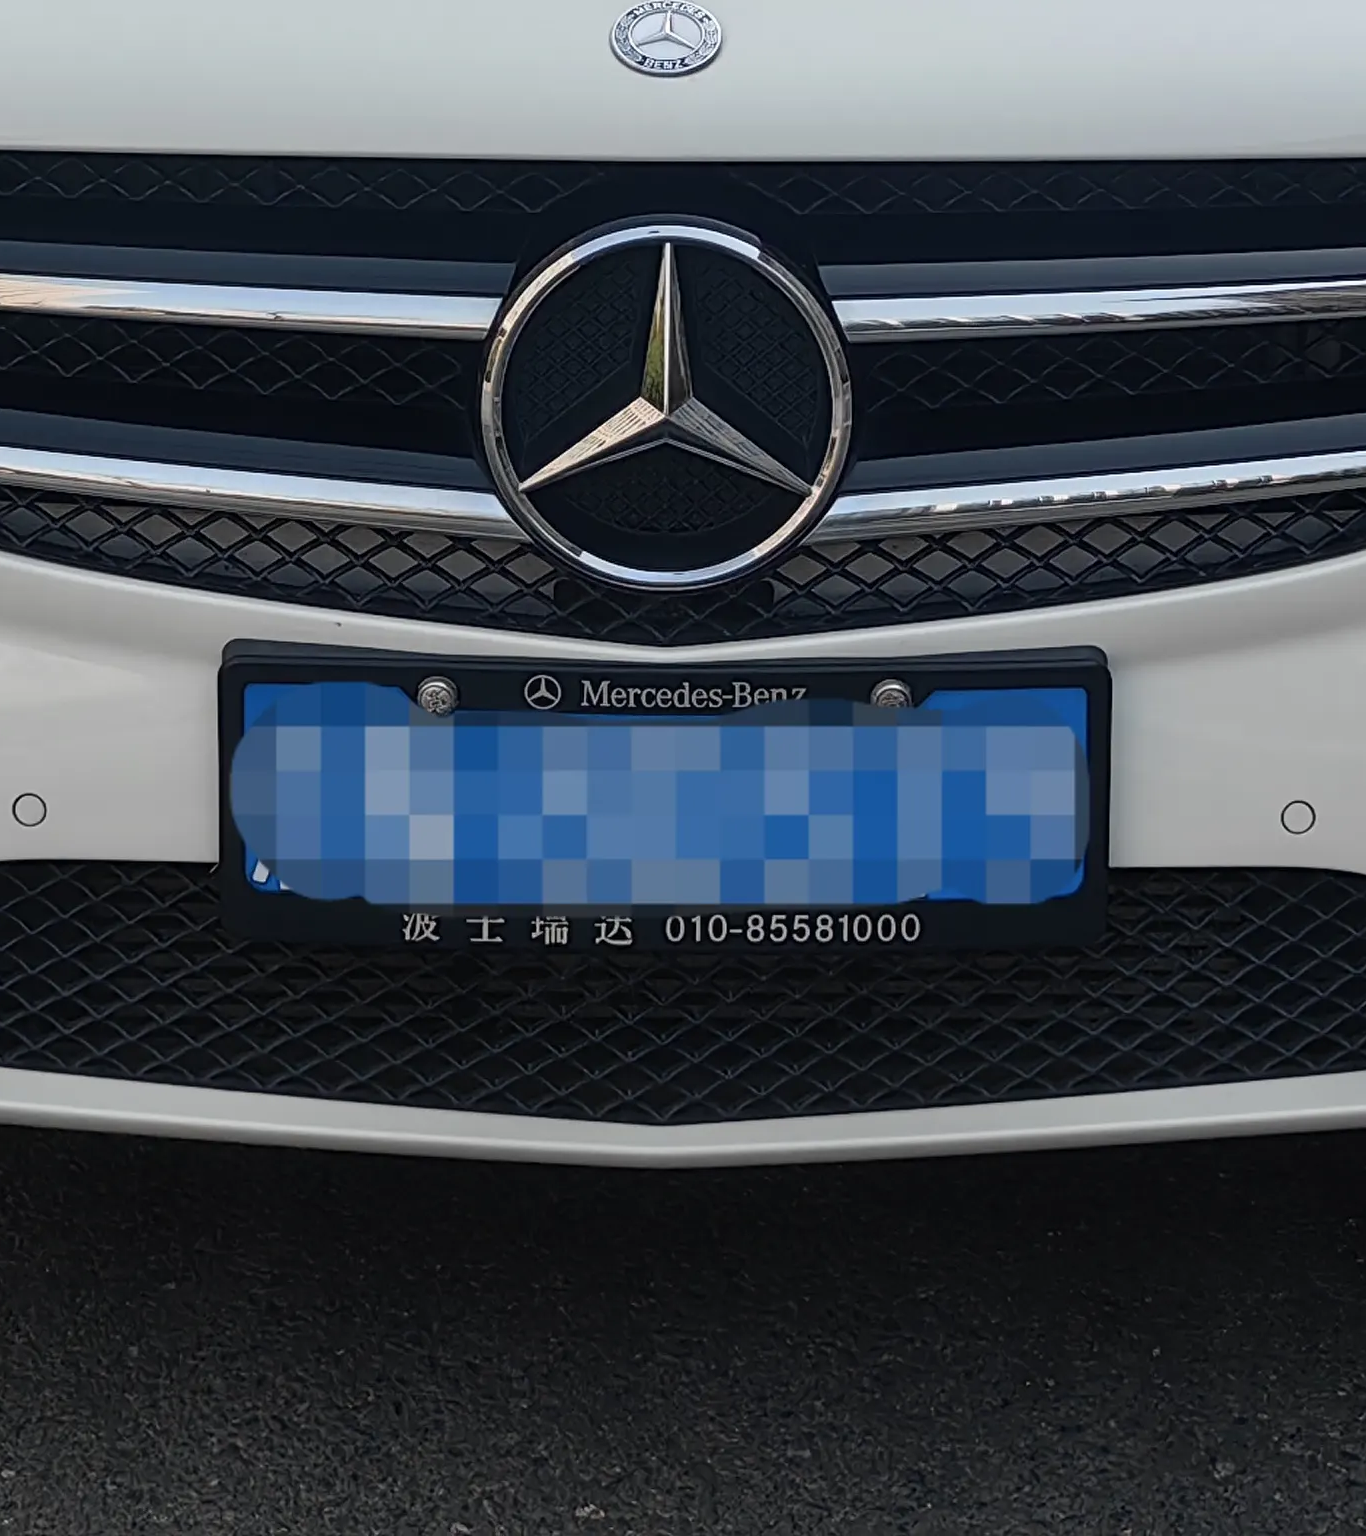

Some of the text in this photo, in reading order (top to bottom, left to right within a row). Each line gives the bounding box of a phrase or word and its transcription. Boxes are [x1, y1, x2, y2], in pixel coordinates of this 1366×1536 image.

[633, 1, 706, 20] MERCEDES
[643, 59, 684, 70] BENZ
[580, 679, 807, 709] Mercedes-Benz
[665, 913, 922, 943] 010-85581000
